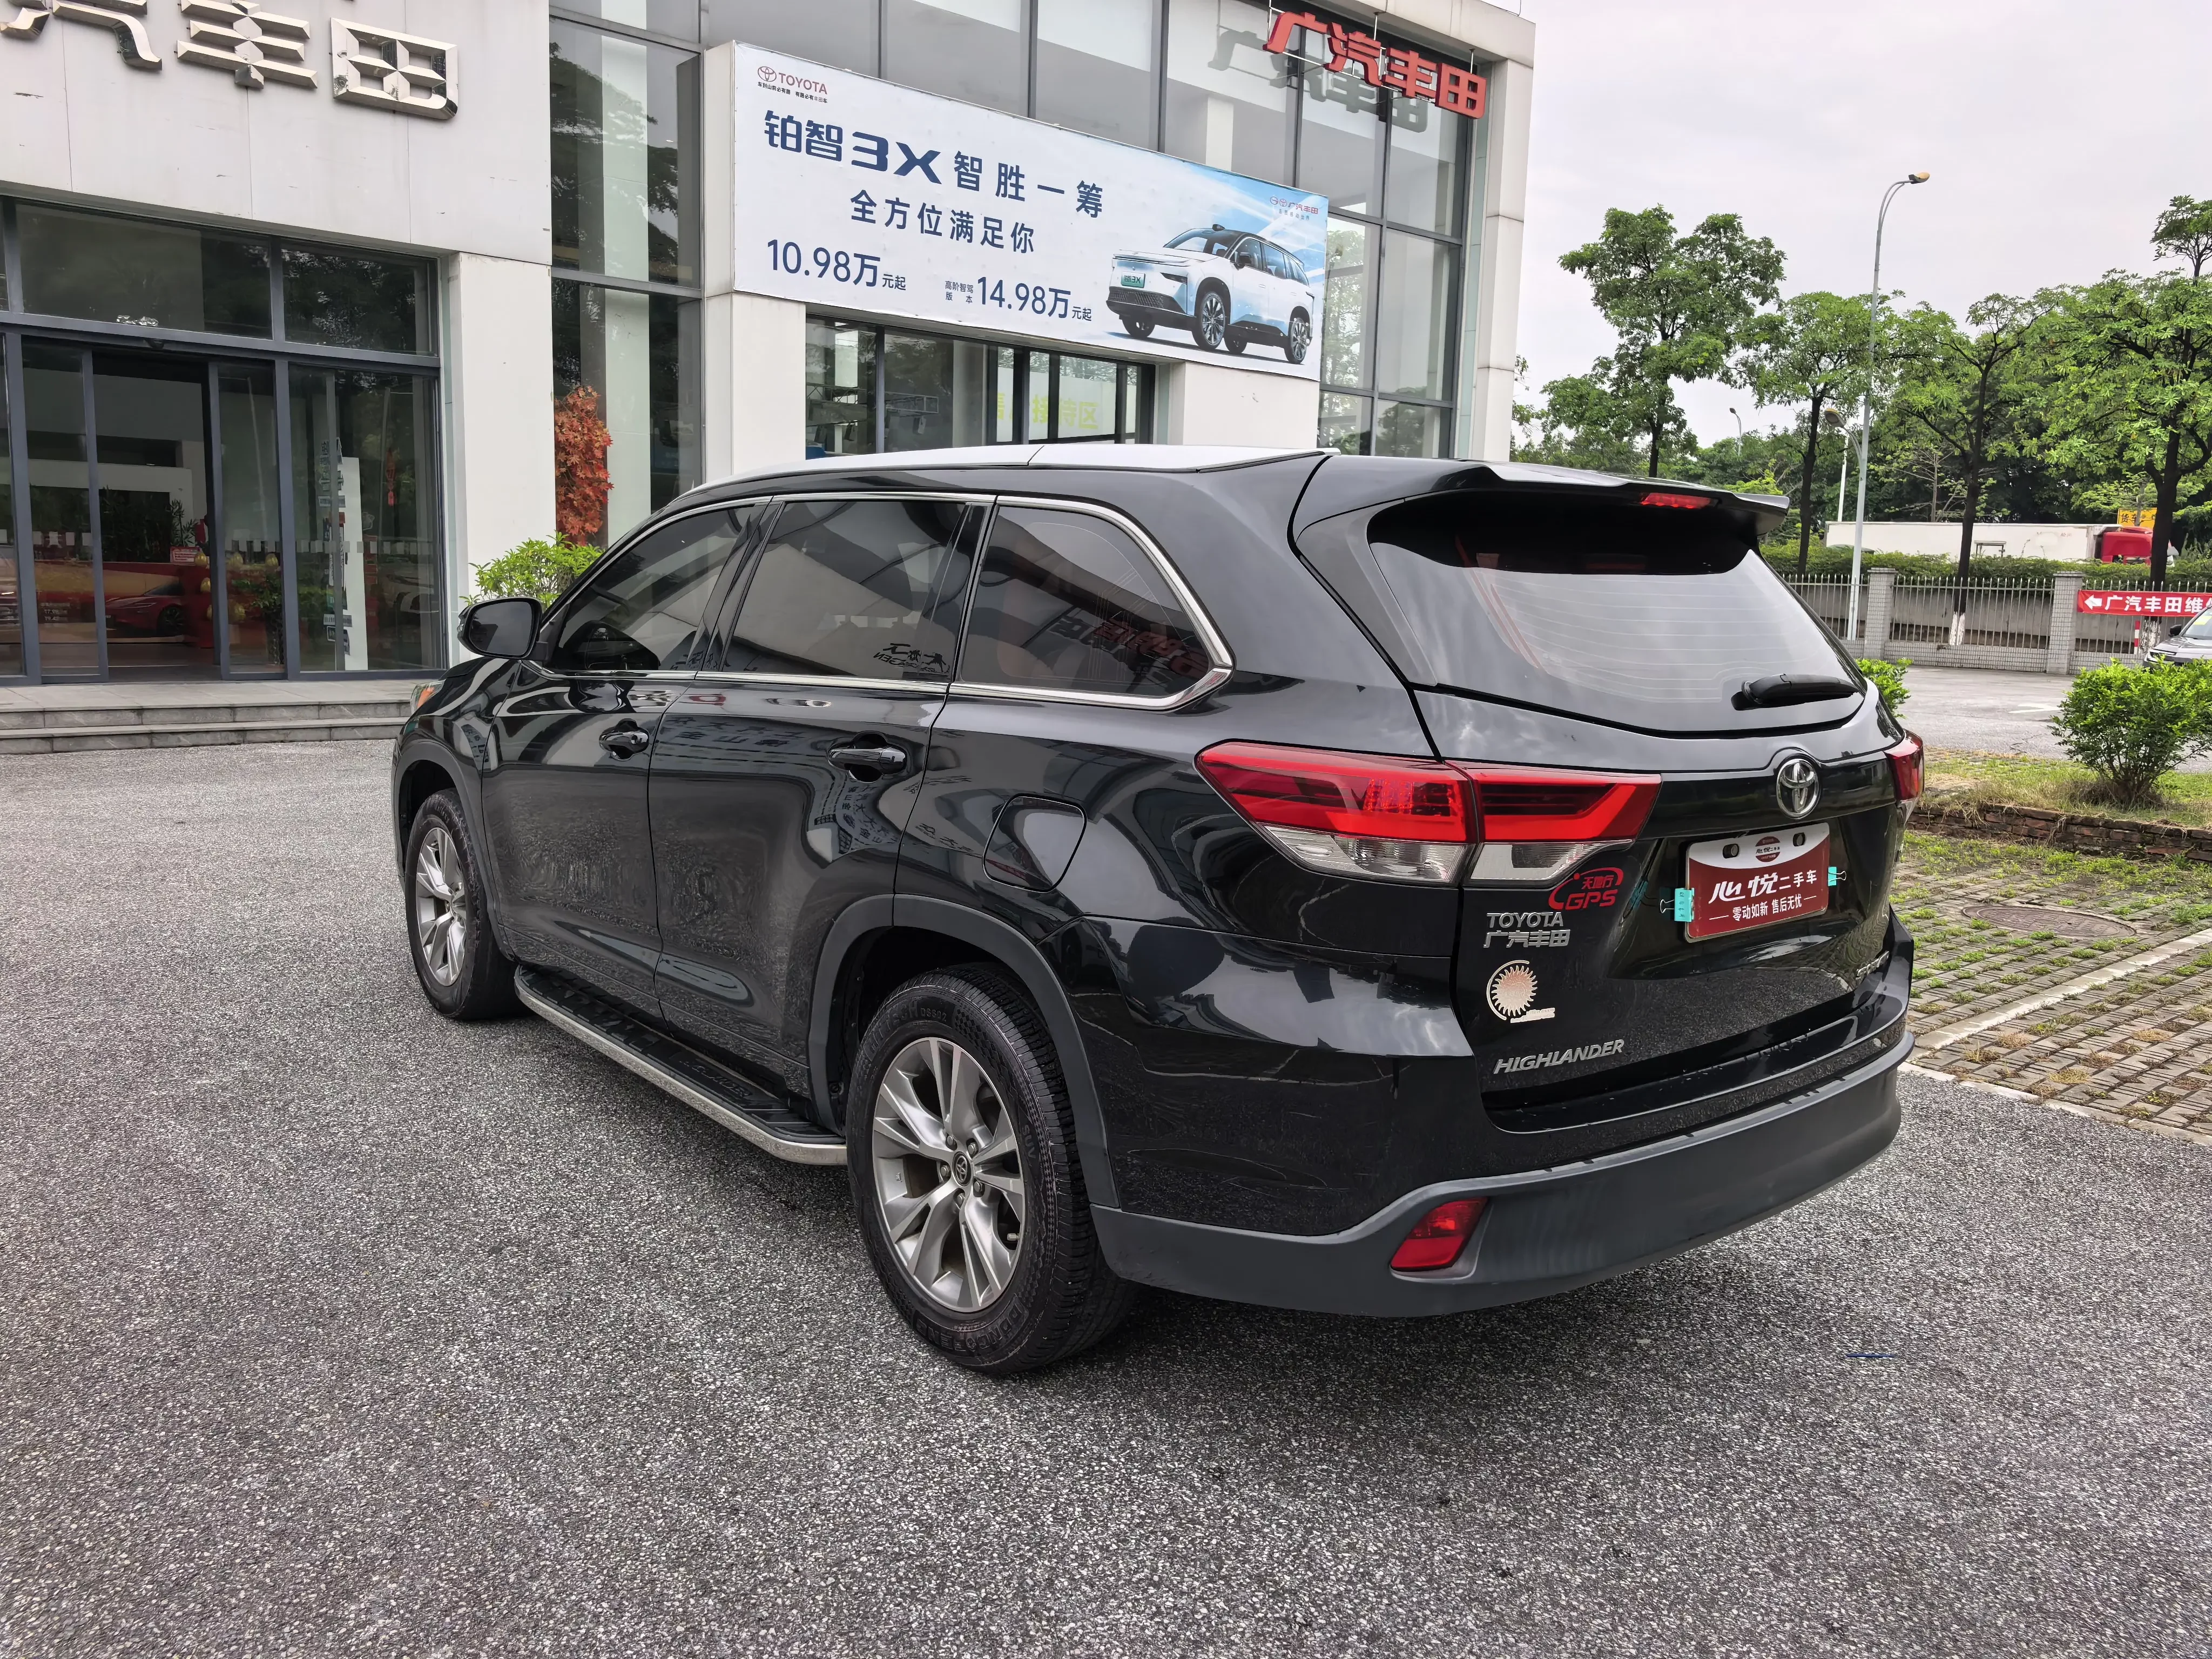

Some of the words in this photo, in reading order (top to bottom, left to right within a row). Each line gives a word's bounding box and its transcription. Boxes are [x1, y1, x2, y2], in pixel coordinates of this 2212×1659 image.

[1263, 11, 1487, 119] 广汽丰田
[778, 72, 827, 95] TOYOTA
[764, 110, 942, 185] 铂智3X
[954, 151, 1103, 218] 智胜一筹
[850, 190, 1035, 254] 全方位满足你
[1565, 889, 1618, 910] GPS
[1708, 869, 1817, 904] 心悦二手车
[1487, 912, 1563, 928] TOYOTA
[1732, 901, 1768, 921] 零动如新
[1771, 894, 1802, 914] 售后无忧
[1483, 929, 1570, 948] 广汽丰田
[1493, 1039, 1624, 1074] HIGHLANDER
[1022, 1124, 1036, 1159] SUV
